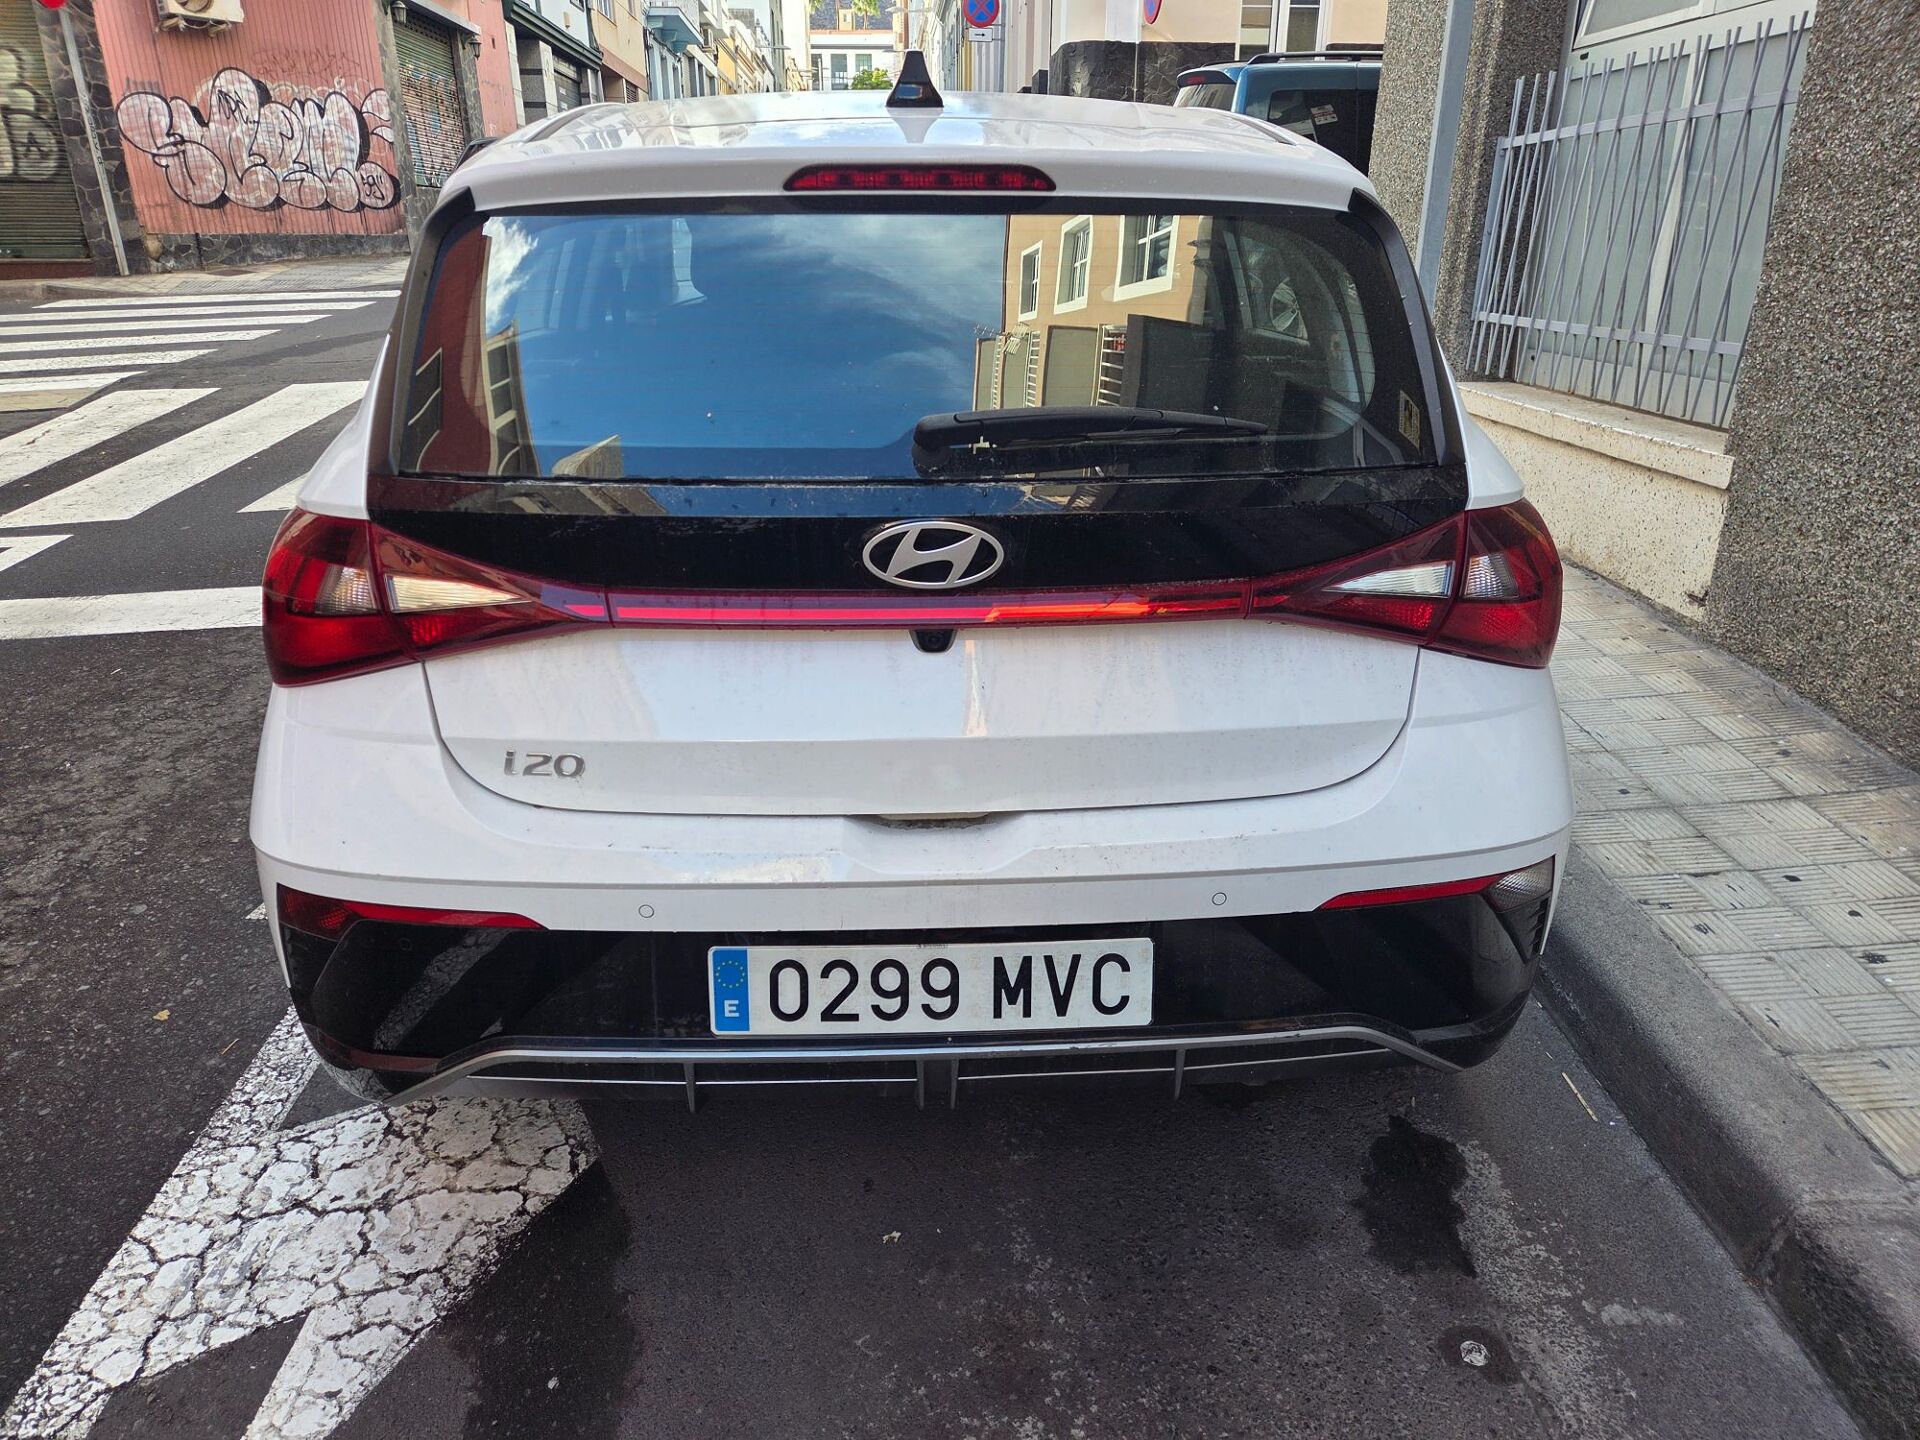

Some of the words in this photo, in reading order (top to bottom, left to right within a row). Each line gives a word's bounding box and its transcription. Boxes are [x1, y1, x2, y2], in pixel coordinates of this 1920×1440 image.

[503, 749, 587, 778] i20
[769, 957, 961, 1023] 0299
[992, 952, 1132, 1020] MVC
[724, 999, 740, 1018] E
